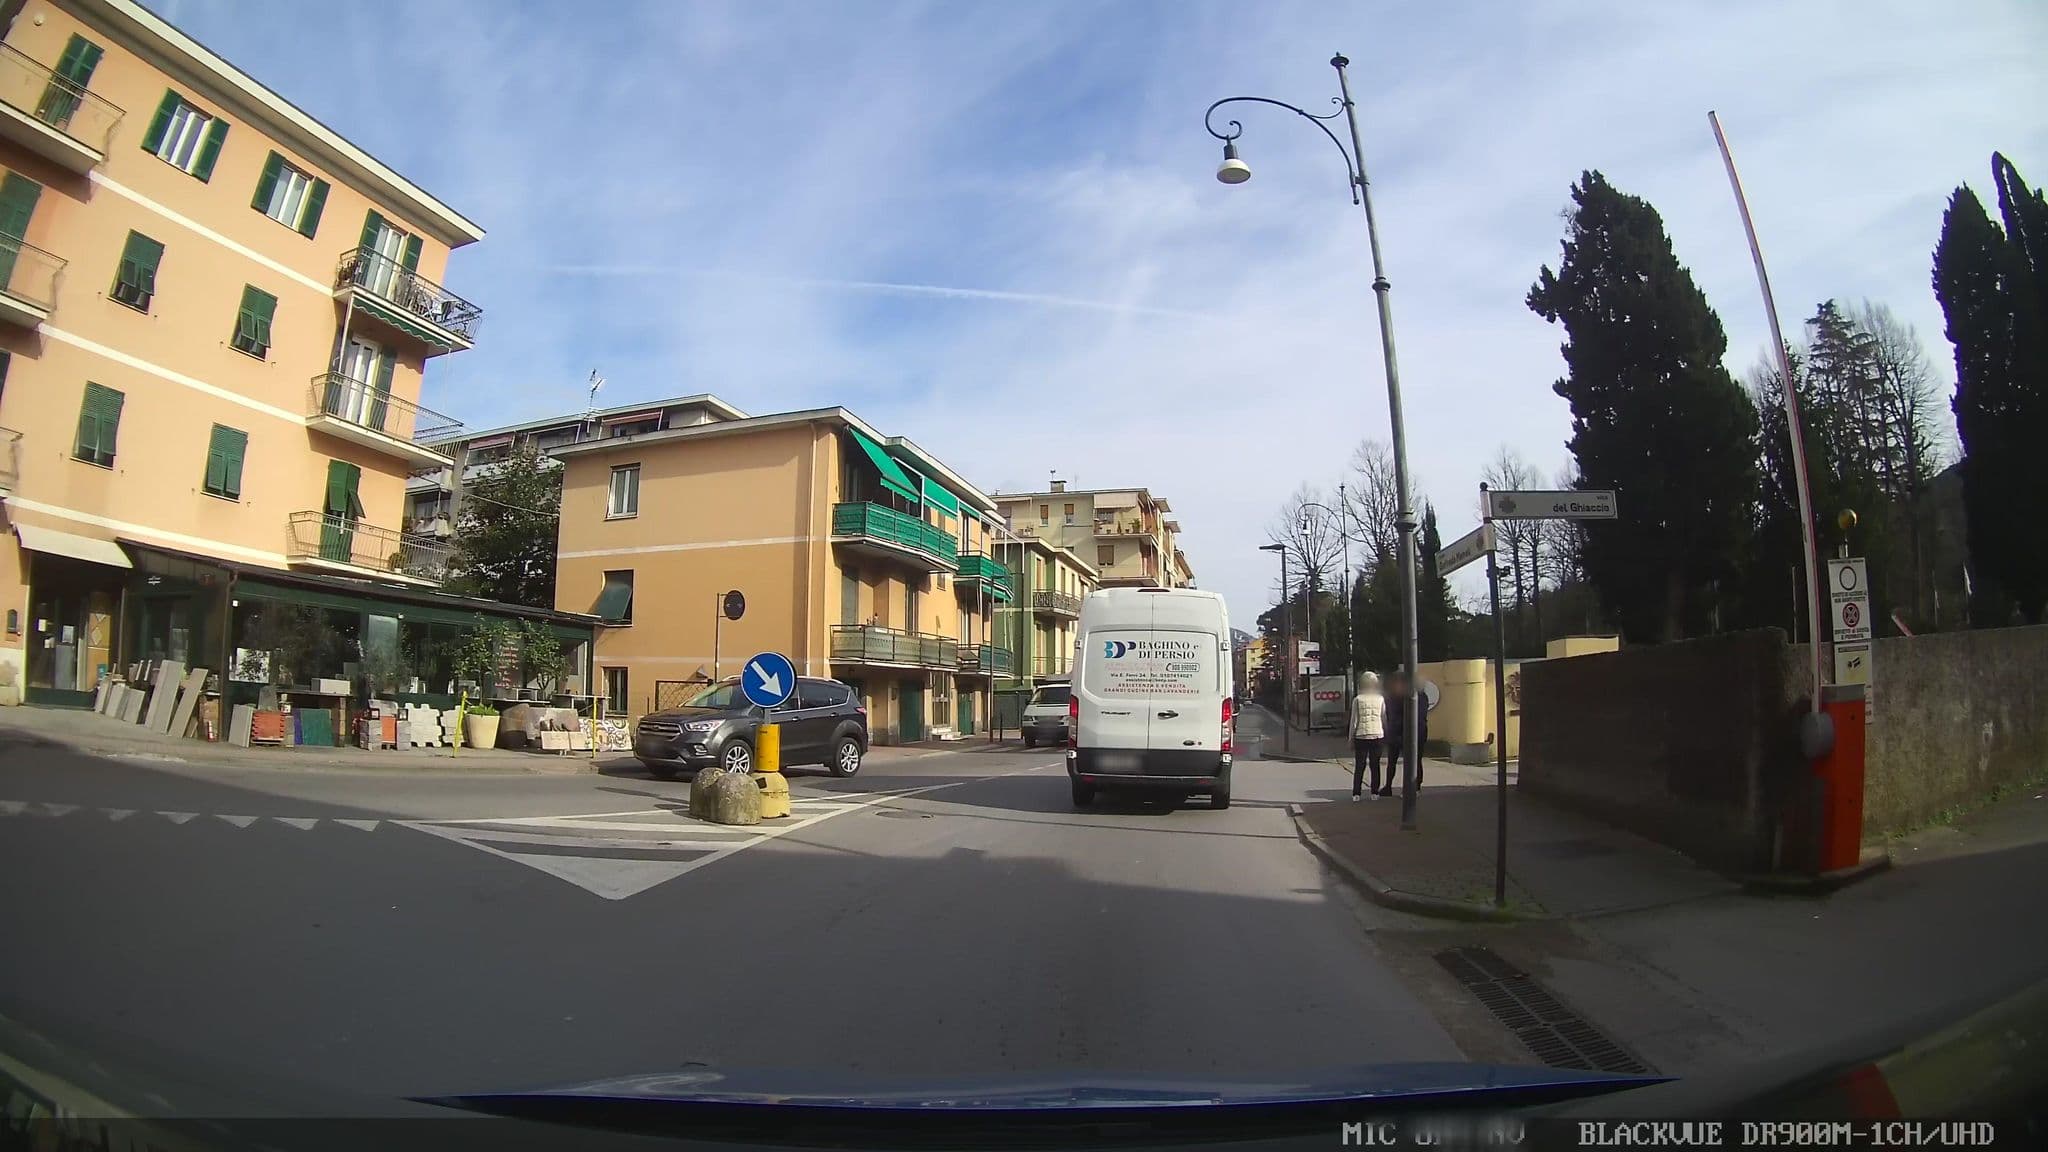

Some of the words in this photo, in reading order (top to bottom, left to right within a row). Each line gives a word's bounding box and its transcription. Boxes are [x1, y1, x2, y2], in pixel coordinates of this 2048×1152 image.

[1553, 503, 1568, 512] del
[1570, 502, 1610, 512] Ghiaccio
[1139, 641, 1190, 650] BAGHINO
[1139, 651, 1150, 659] DI
[1154, 651, 1195, 659] PERSIO
[1314, 692, 1341, 702] coop
